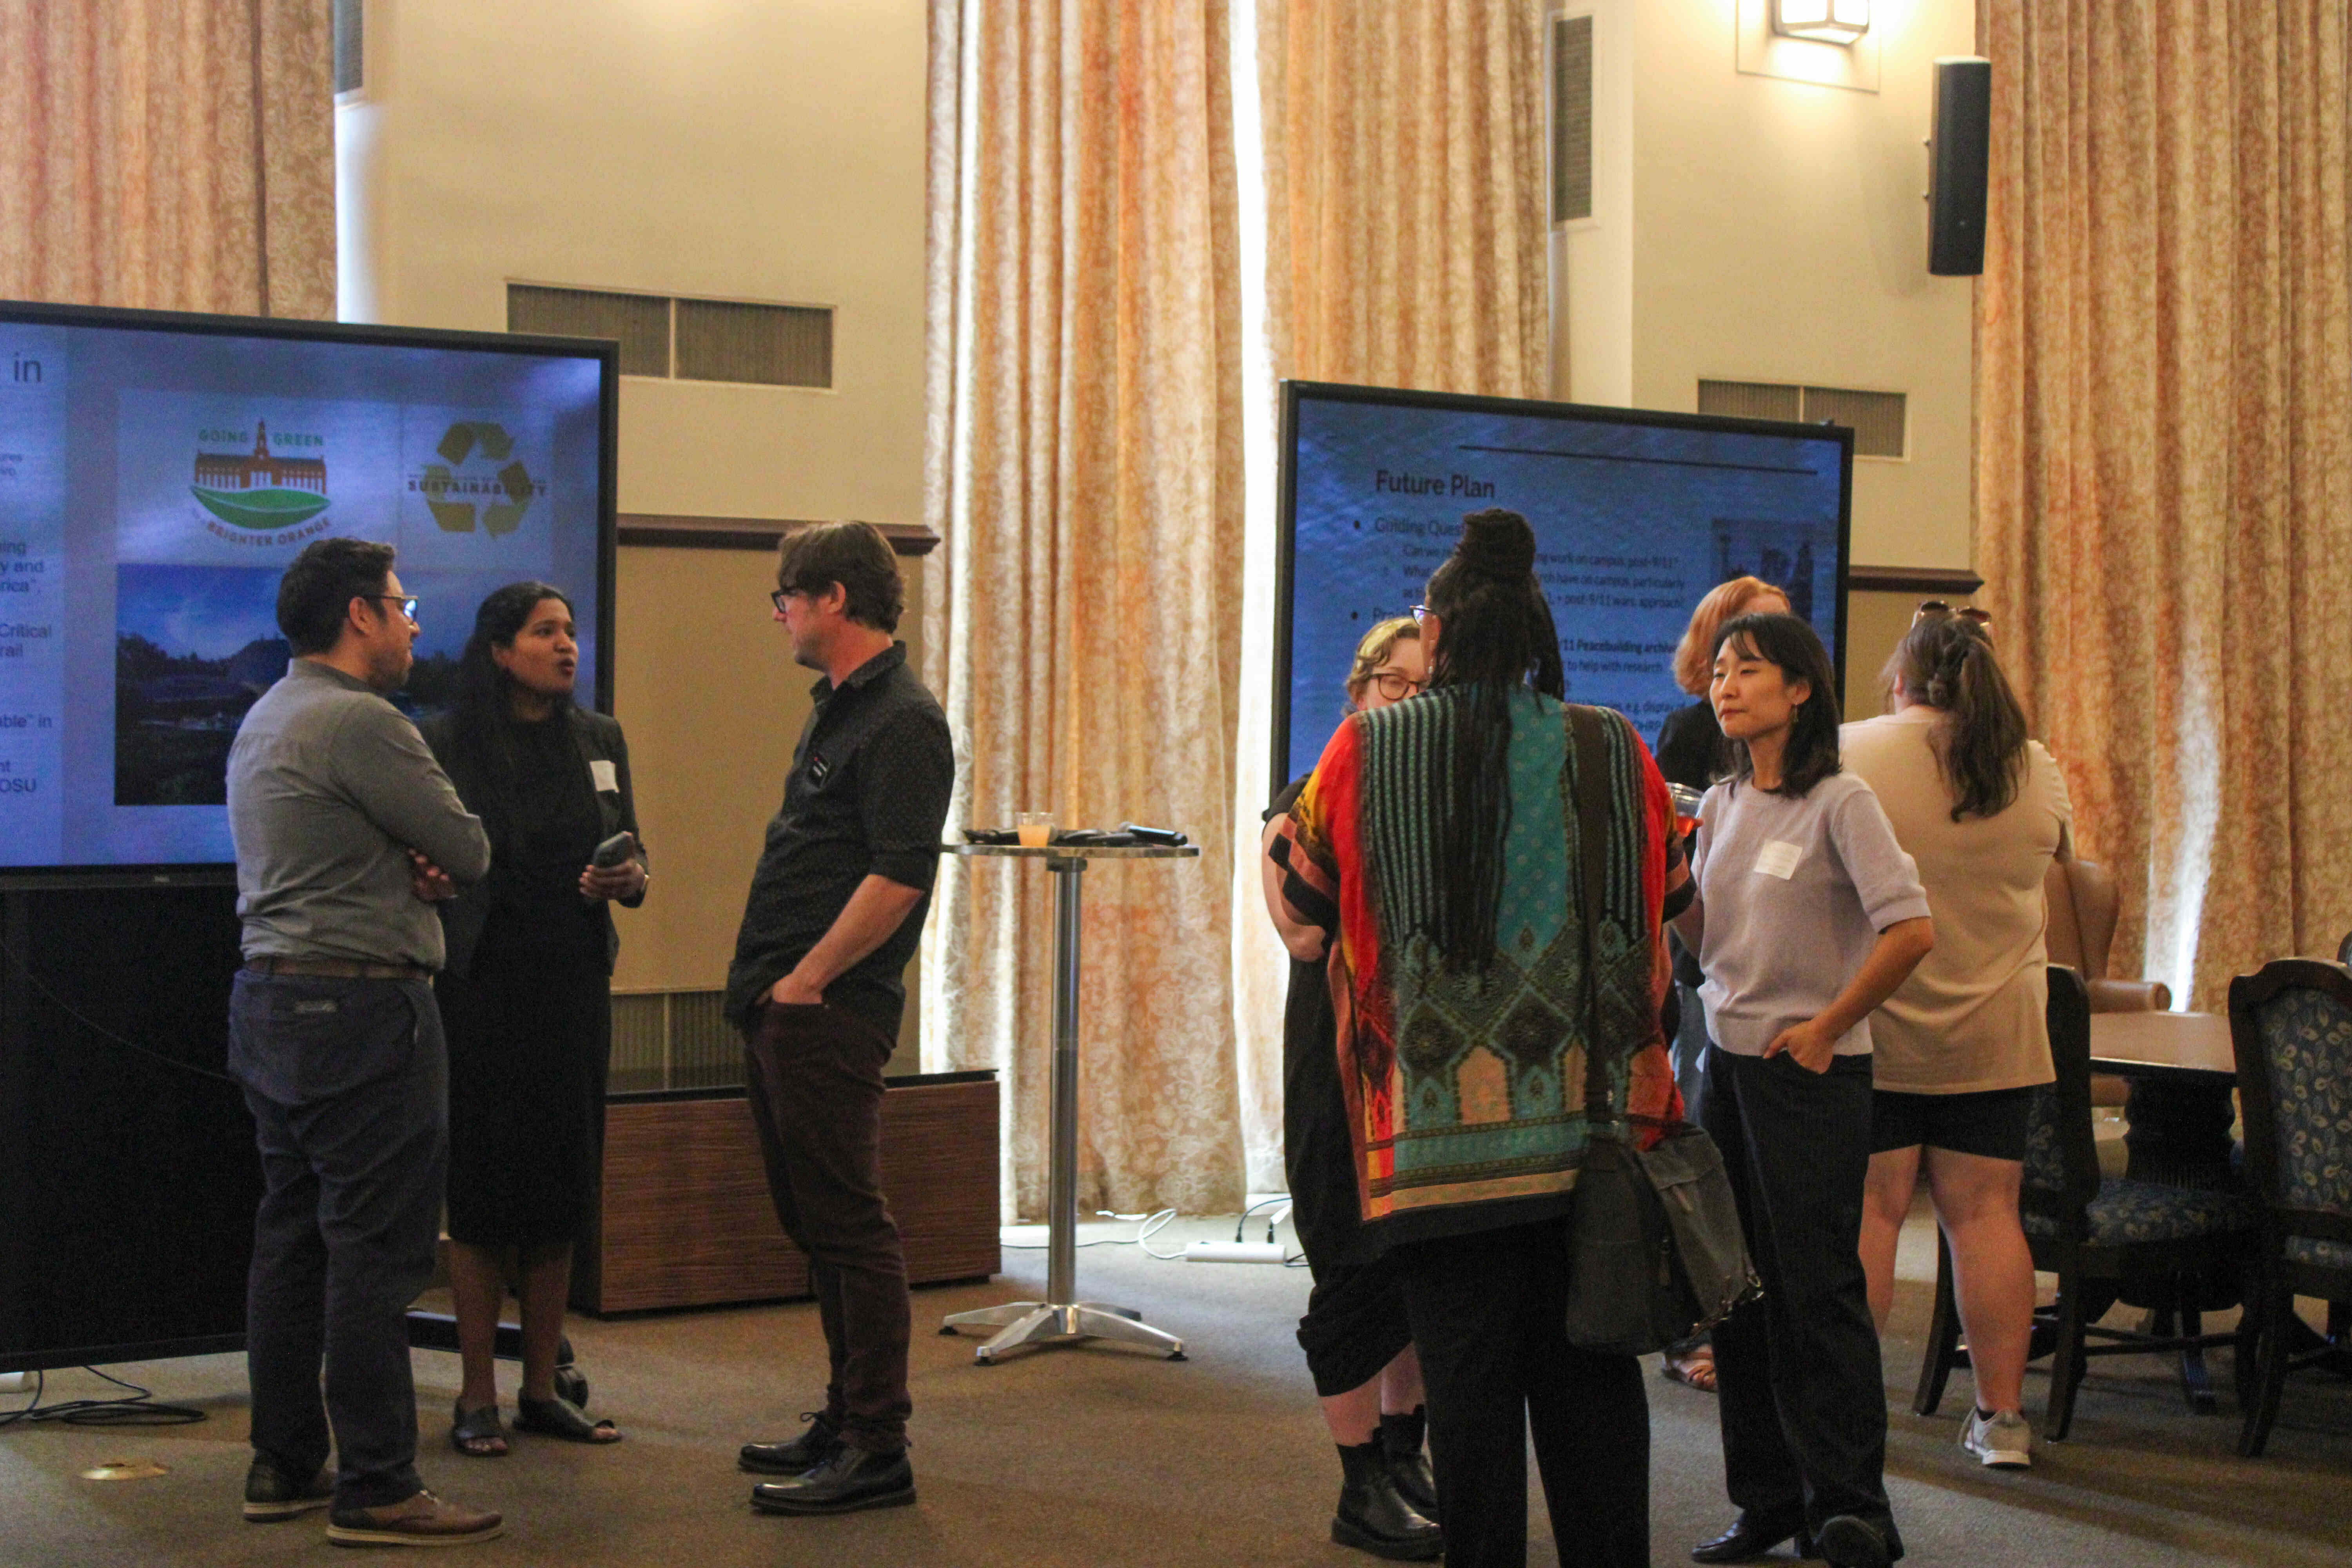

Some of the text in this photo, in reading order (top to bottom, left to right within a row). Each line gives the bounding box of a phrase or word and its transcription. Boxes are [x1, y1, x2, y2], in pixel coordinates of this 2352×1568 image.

[15, 351, 41, 382] in
[198, 429, 324, 446] GOING GREEN
[408, 480, 546, 497] SUSTAINABY
[1376, 469, 1495, 499] Future Plan
[207, 516, 332, 546] BRIGHTER ORANGE
[1428, 519, 1465, 537] Ques
[15, 559, 44, 573] and
[38, 712, 53, 728] in
